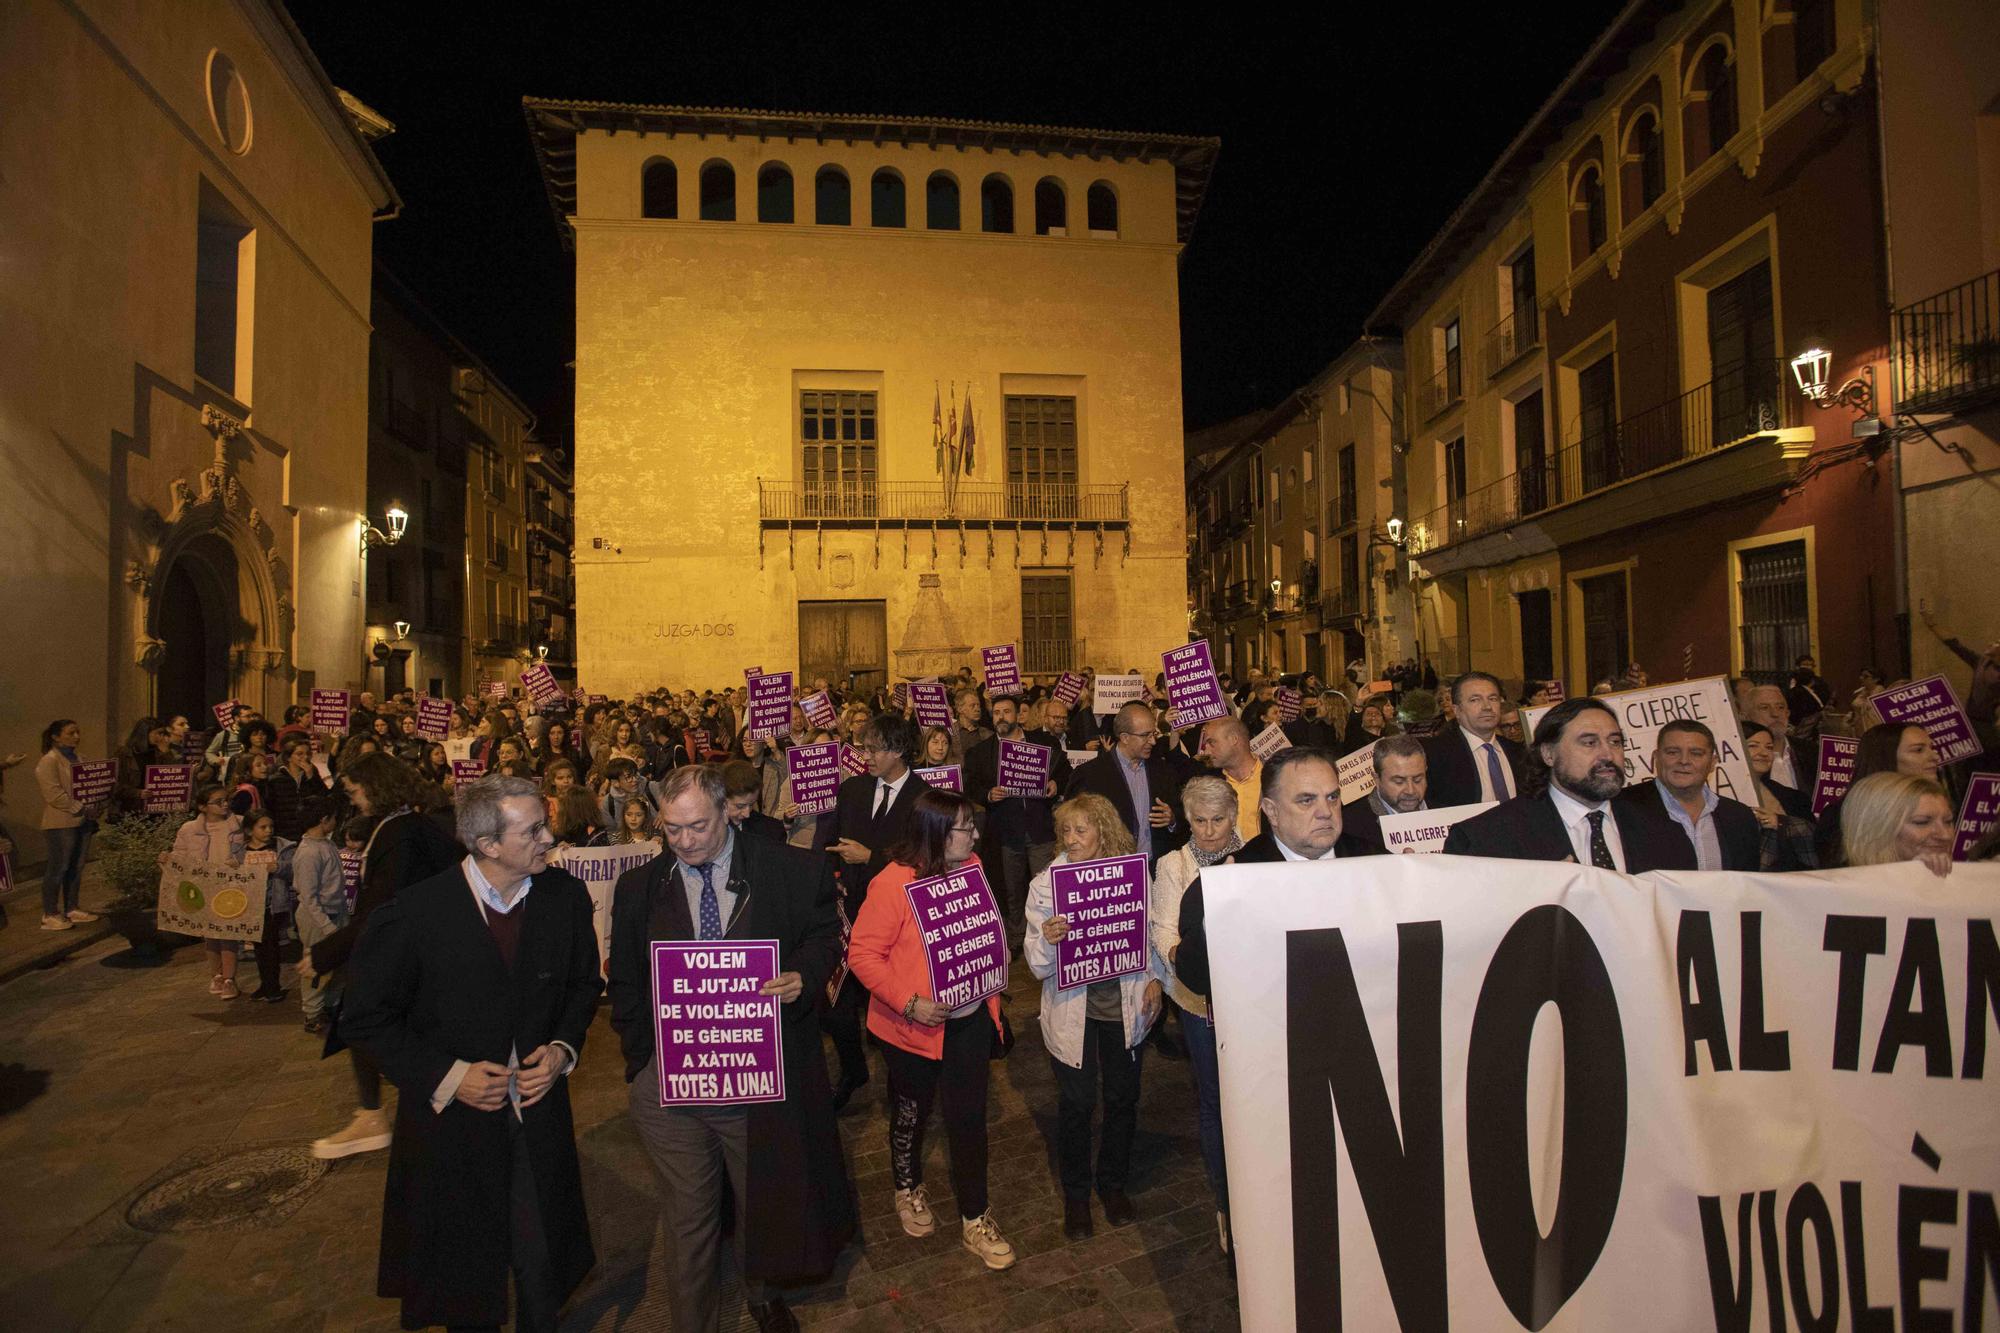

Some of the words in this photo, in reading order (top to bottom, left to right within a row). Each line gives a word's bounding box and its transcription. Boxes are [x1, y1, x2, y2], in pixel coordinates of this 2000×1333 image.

[654, 623, 735, 638] JUZGADOS
[1172, 647, 1196, 662] VOLEM
[1169, 666, 1178, 674] EL
[1178, 658, 1203, 672] JUTJAT
[759, 676, 782, 686] VOLEM
[1167, 679, 1175, 687] DE
[1175, 669, 1213, 685] VIOLÈNCIA
[755, 689, 763, 697] EL
[764, 686, 786, 696] JUTJAT
[1172, 690, 1181, 698] DE
[1181, 681, 1211, 696] GÈNERE
[1889, 685, 1930, 704] VOLEM
[760, 695, 792, 706] VIOLÈNCIA
[1177, 701, 1183, 709] A
[1183, 694, 1211, 708] XÀTIVA
[1888, 707, 1904, 718] EL
[1905, 694, 1942, 713] JUTJAT
[764, 706, 788, 716] GÈNERE
[1197, 706, 1205, 717] A
[1202, 702, 1222, 719] UNA!
[1626, 693, 1708, 729] CIERRE
[764, 716, 785, 726] XÀTIVA
[752, 727, 772, 739] TOTES
[800, 747, 828, 758] VOLEM
[1012, 744, 1038, 755] VOLEM
[1940, 746, 1950, 760] A
[1948, 738, 1975, 758] UNA!
[796, 761, 805, 769] EL
[806, 756, 833, 768] JUTJAT
[1010, 762, 1046, 773] VIOLÈNCIA
[1016, 755, 1041, 764] JUTJAT
[1827, 756, 1838, 767] EL
[1839, 758, 1856, 768] JUT
[791, 772, 801, 780] DE
[802, 766, 839, 779] VIOLÈNCIA
[921, 771, 948, 781] VOLEM
[1014, 772, 1041, 780] GÈNERE
[1819, 771, 1831, 781] DE
[807, 777, 836, 788] GÈNERE
[1013, 780, 1037, 788] XÀTIVA
[1822, 786, 1834, 796] DE
[808, 788, 833, 799] XÀTIVA
[800, 800, 817, 813] OTES
[818, 799, 824, 810] A
[1975, 801, 1990, 813] EL
[1960, 819, 1977, 832] DE
[1389, 832, 1402, 845] NO
[1404, 830, 1416, 843] AL
[1415, 825, 1448, 841] CIERRE
[1075, 865, 1124, 884] VOLEM
[927, 876, 968, 899] VOLEM
[1068, 891, 1084, 904] EL
[1086, 883, 1134, 901] JUTJAT
[927, 906, 943, 921] EL
[944, 893, 982, 915] JUTJAT
[1078, 900, 1144, 921] VIOLÈNCIA
[925, 929, 942, 945] DE
[942, 909, 998, 939] VIOLÈNCIA
[1067, 929, 1084, 941] DE
[1086, 920, 1136, 938] GÈNERE
[937, 948, 954, 963] DE
[954, 931, 996, 957] GÈNERE
[1074, 947, 1082, 959] A
[1086, 938, 1130, 956] XÀTIVA
[683, 952, 747, 969] VOLEM
[947, 968, 956, 983] A
[956, 953, 994, 978] XÀTIVA
[1063, 959, 1100, 984] TOTES
[1103, 956, 1111, 975] A
[1114, 950, 1141, 972] UNA!
[673, 979, 693, 994] EL
[697, 977, 759, 994] JUTJAT
[939, 977, 972, 1007] TOTES
[973, 976, 980, 998] A
[981, 965, 1003, 993] UNA!
[1677, 909, 1790, 1078] AL
[660, 1004, 682, 1019] DE
[685, 1000, 774, 1019] VIOLÈNCIA
[672, 1030, 694, 1044] DE
[698, 1026, 763, 1043] GÈNERE
[682, 1054, 694, 1068] A
[698, 1051, 757, 1067] XÀTIVA
[668, 1073, 719, 1098] TOTES
[722, 1072, 734, 1097] A
[737, 1071, 775, 1096] UNA!
[1285, 903, 1628, 1333] NO
